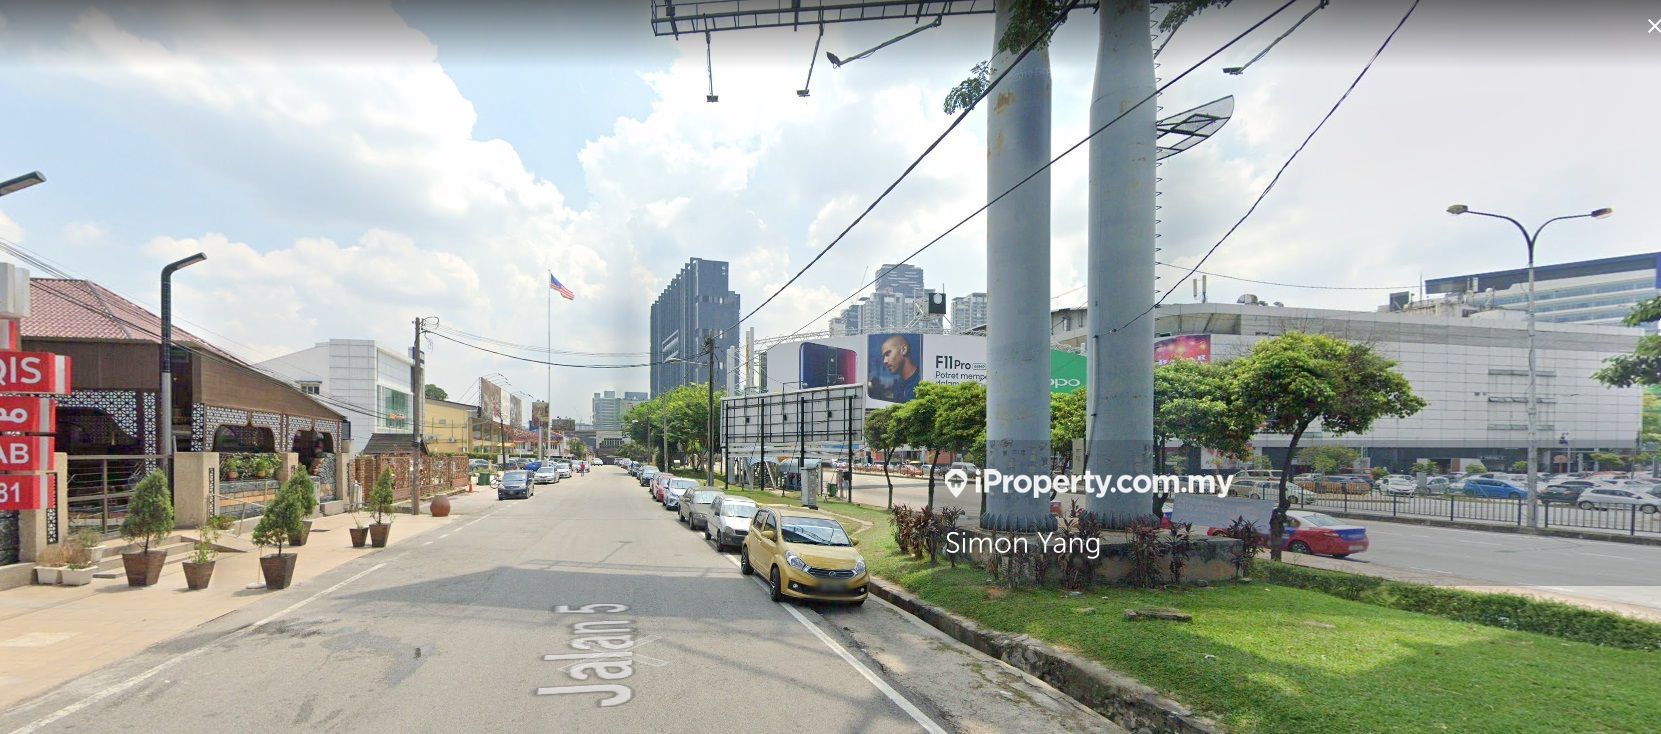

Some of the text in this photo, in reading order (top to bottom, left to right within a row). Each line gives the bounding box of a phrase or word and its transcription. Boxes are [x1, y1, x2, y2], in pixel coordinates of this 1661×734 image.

[935, 355, 953, 370] F11
[954, 359, 971, 370] Pro
[935, 370, 959, 379] Potret
